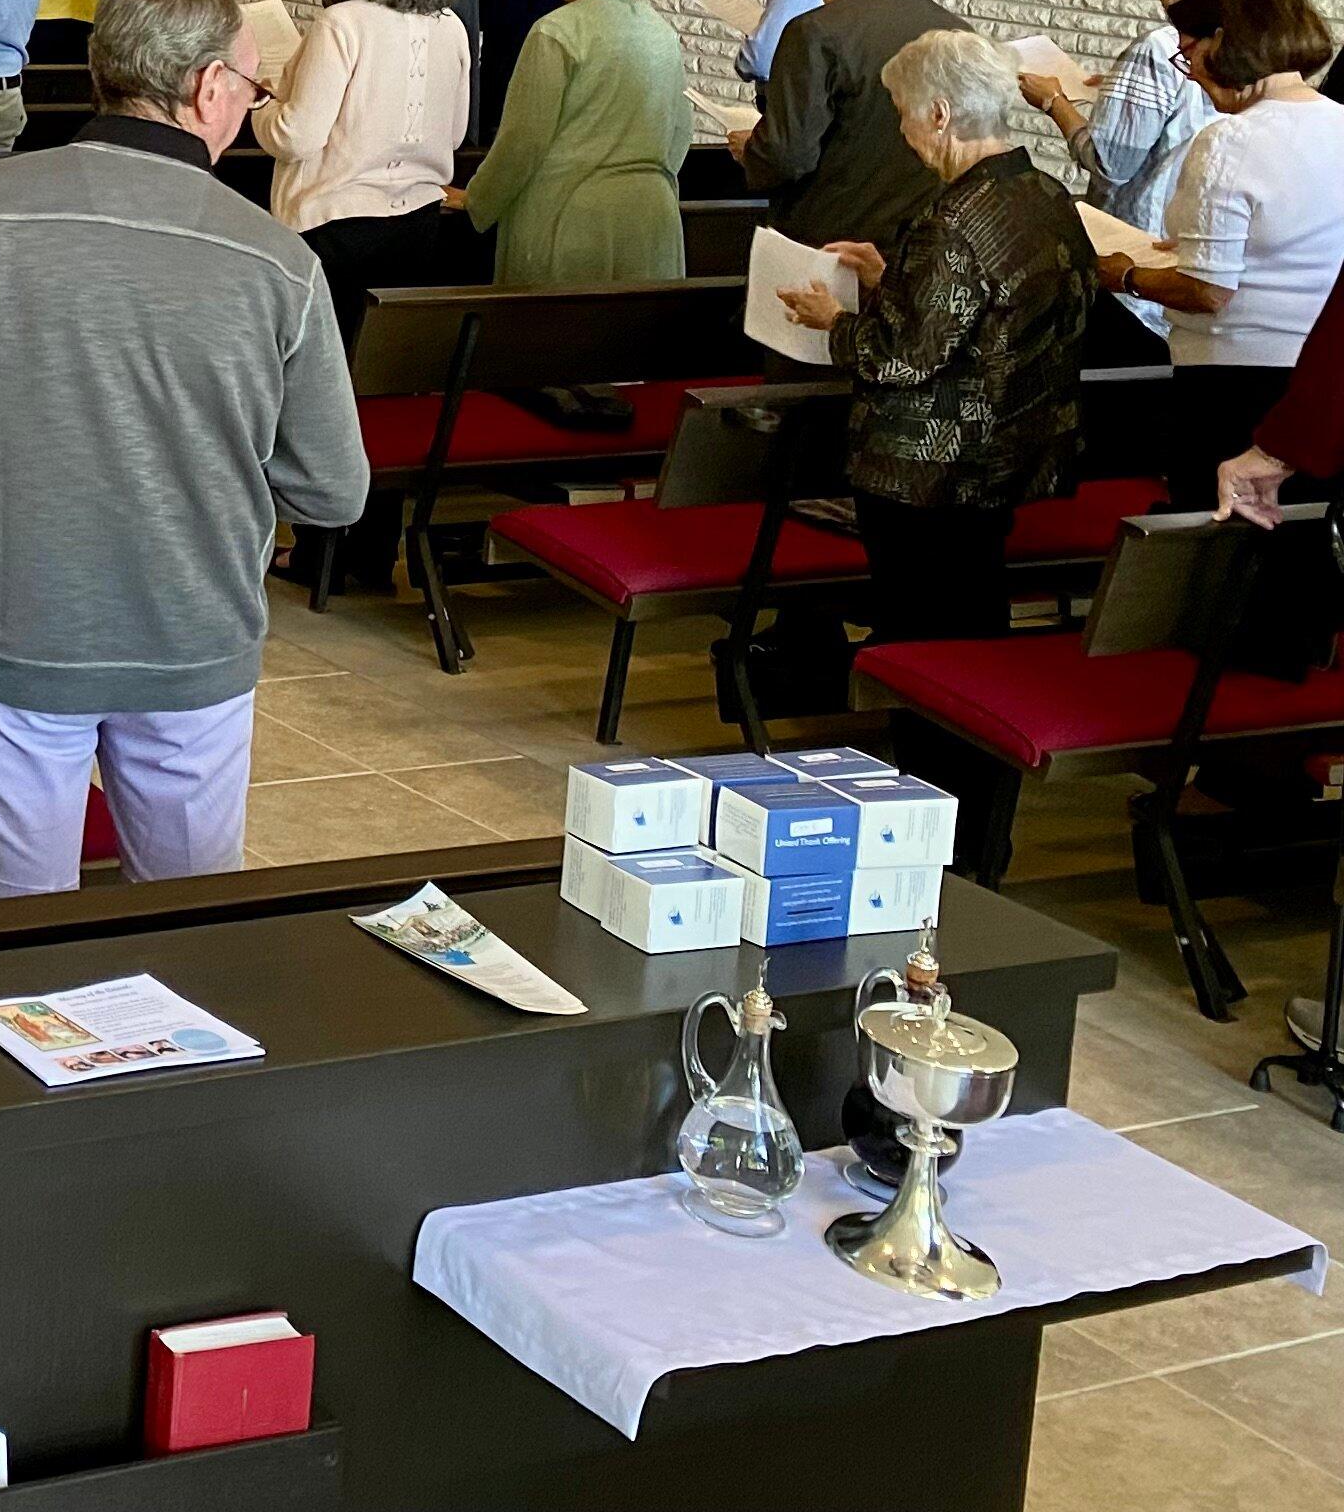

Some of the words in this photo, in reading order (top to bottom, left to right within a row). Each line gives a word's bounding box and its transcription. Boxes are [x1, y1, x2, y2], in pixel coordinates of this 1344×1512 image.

[774, 838, 799, 848] United
[800, 838, 821, 847] Thank
[822, 836, 851, 847] Offering
